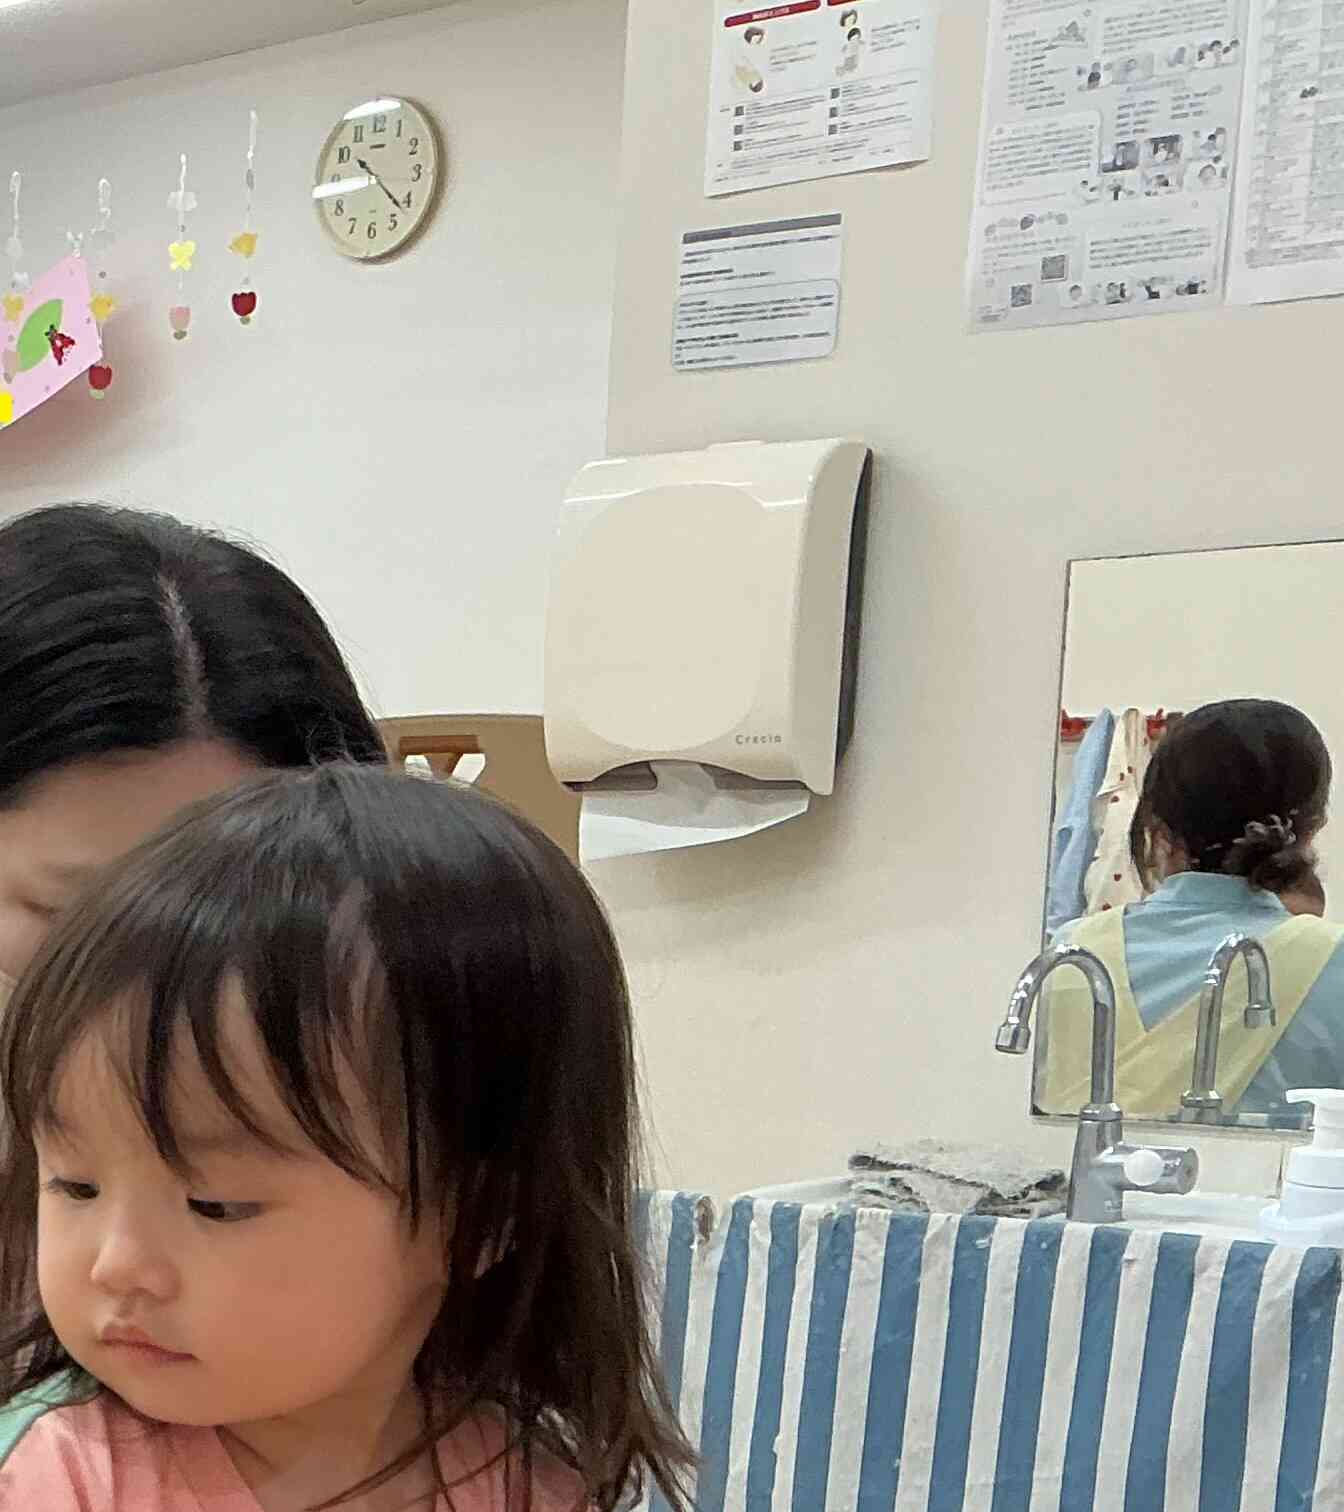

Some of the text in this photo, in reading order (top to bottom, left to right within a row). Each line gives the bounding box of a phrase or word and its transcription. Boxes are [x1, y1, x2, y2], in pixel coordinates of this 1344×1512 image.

[372, 115, 386, 133] 12
[395, 119, 402, 137] 1
[353, 125, 365, 143] 11
[338, 146, 351, 164] 10
[409, 137, 418, 155] 2
[412, 163, 422, 182] 3
[334, 200, 344, 216] 8
[402, 191, 411, 208] 4
[348, 217, 357, 234] 7
[367, 222, 377, 239] 6
[388, 214, 398, 231] 5
